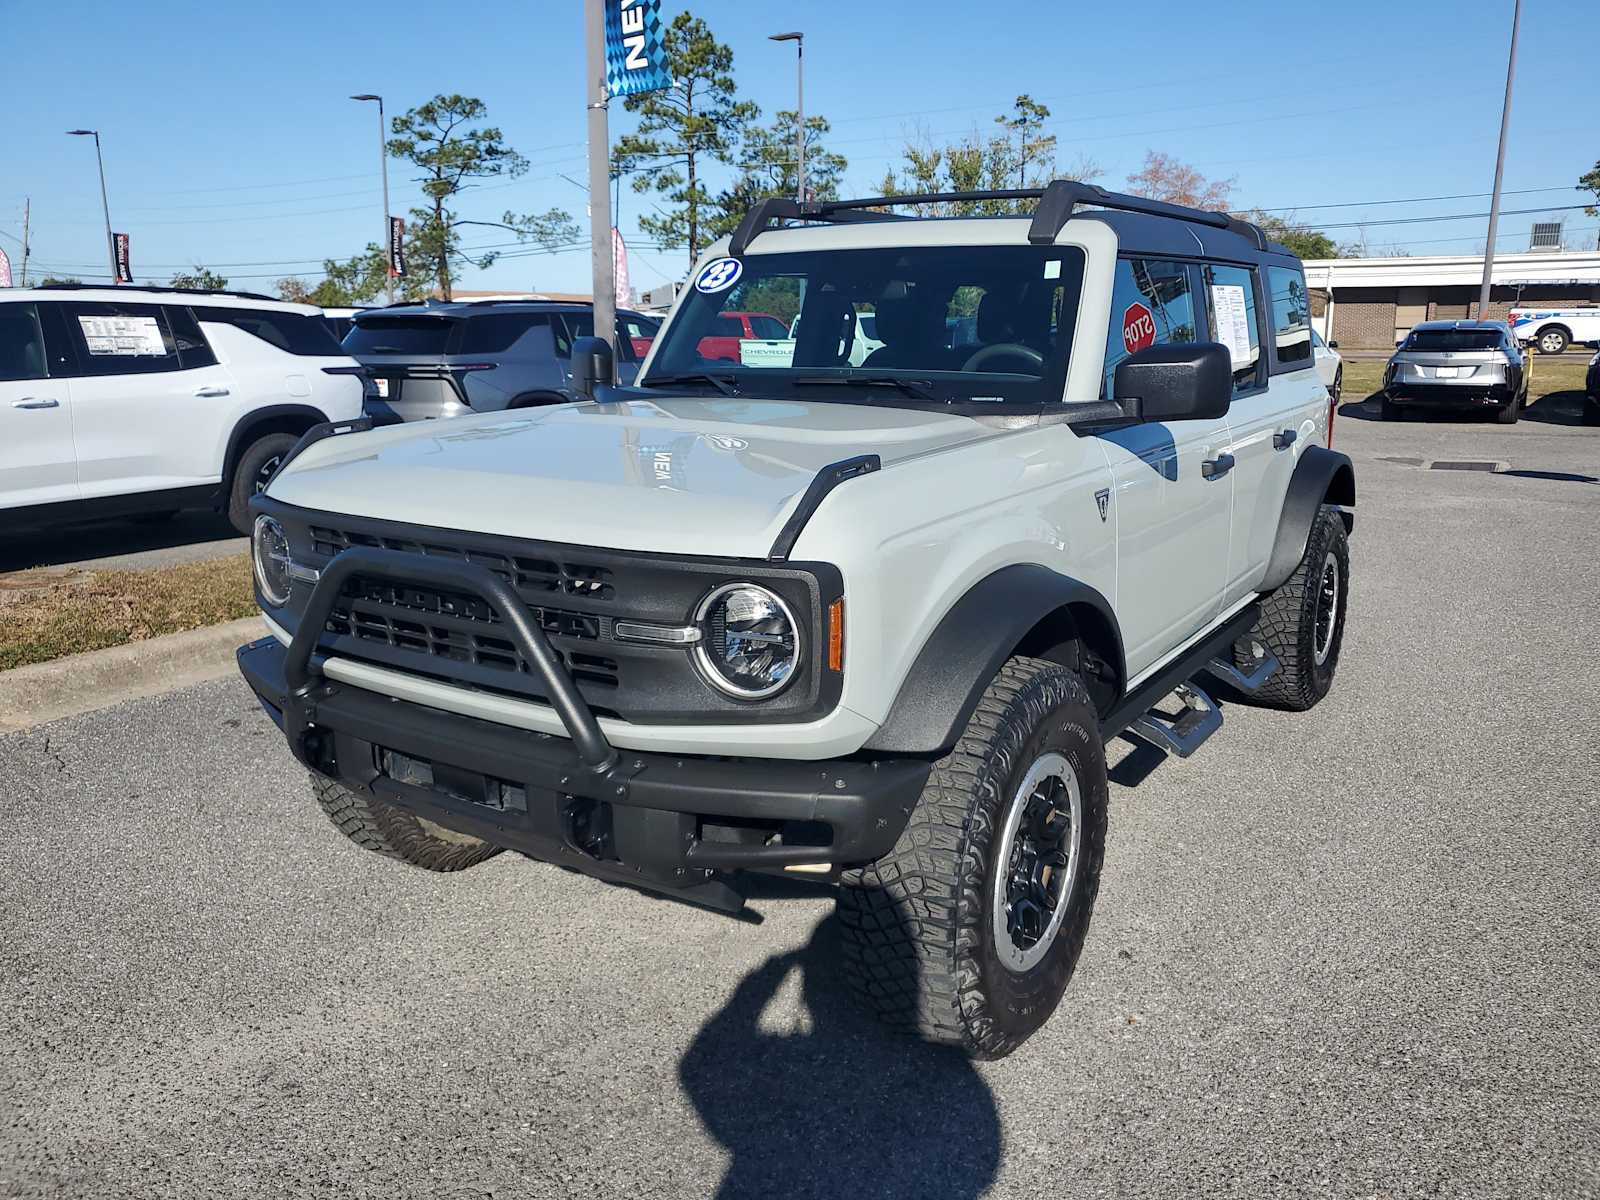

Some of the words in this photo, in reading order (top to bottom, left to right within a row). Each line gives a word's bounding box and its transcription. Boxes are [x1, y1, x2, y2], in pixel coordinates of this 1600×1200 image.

[117, 235, 125, 263] TRUCKS
[119, 264, 128, 281] NEW
[394, 254, 402, 273] NEW
[699, 262, 736, 288] 23
